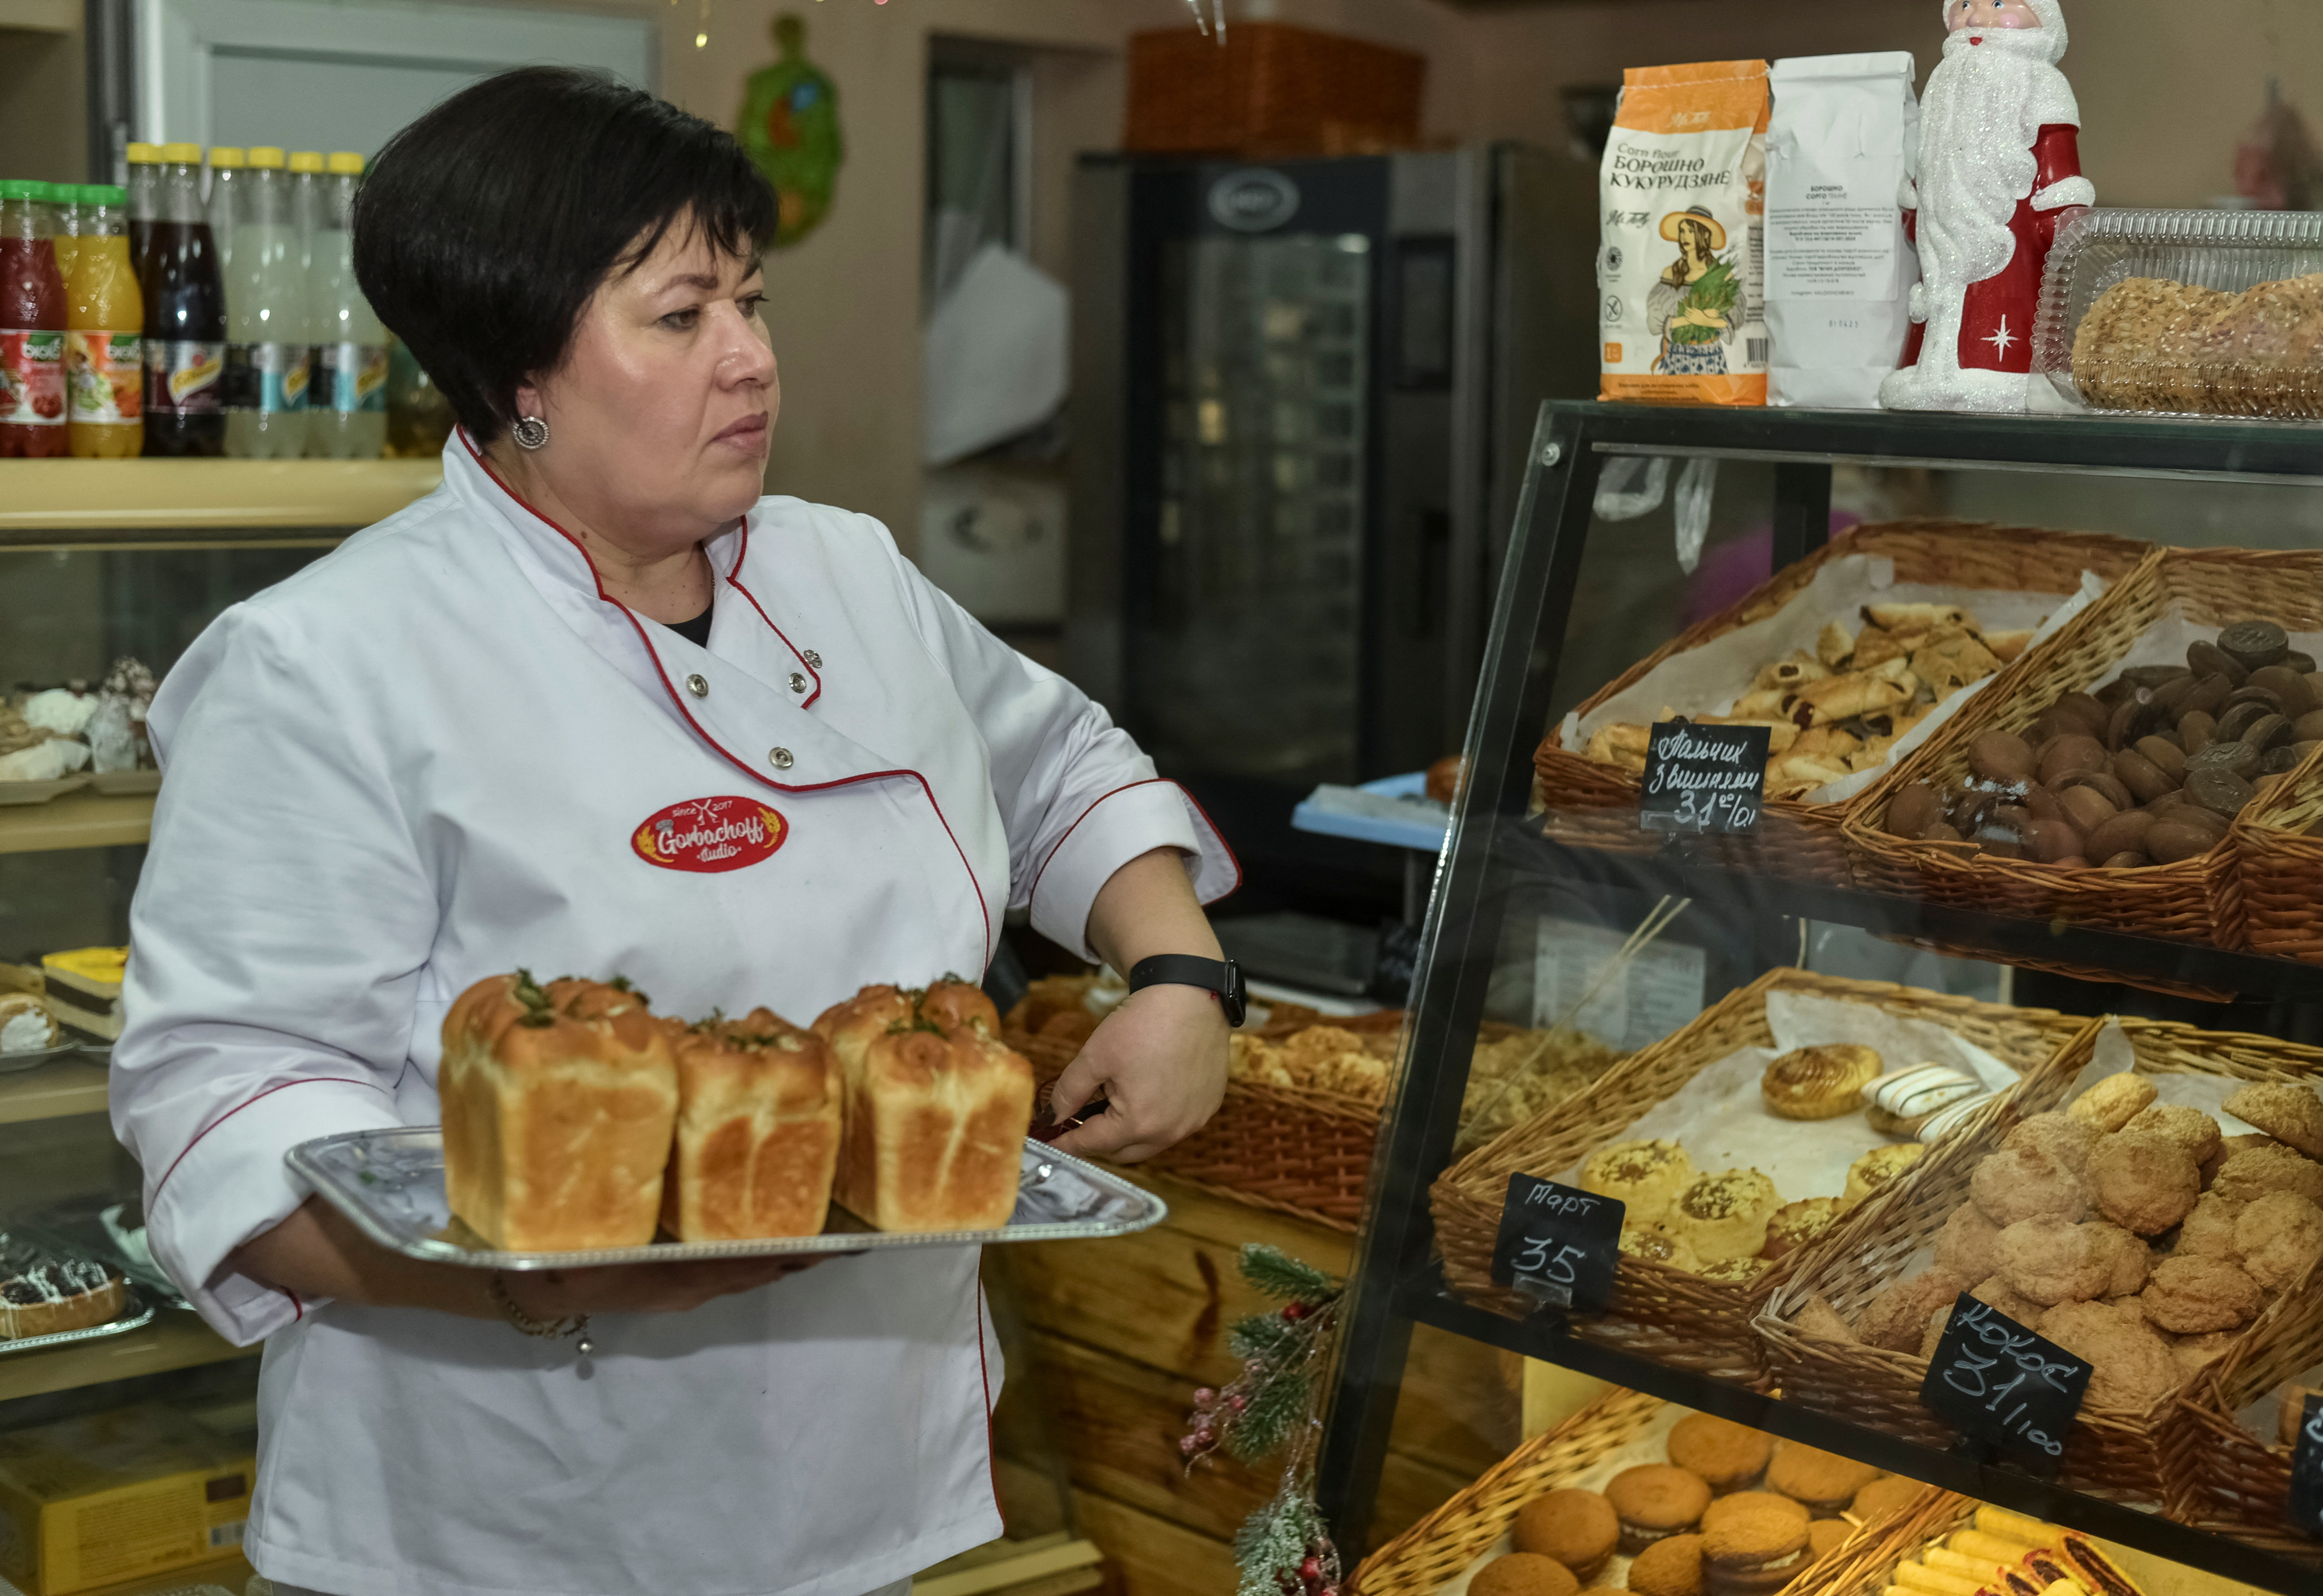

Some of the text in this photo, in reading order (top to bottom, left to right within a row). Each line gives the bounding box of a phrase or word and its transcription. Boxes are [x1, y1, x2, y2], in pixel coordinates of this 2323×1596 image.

[1617, 142, 1649, 157] Corn
[1614, 155, 1704, 174] БОРОШНО
[1610, 170, 1731, 190] КУКУРУДЗЯНЕ
[1658, 728, 1748, 764] Пальчик
[672, 800, 733, 817] since 2017
[658, 816, 764, 854] Gorbachoff
[1510, 1236, 1586, 1283] 35
